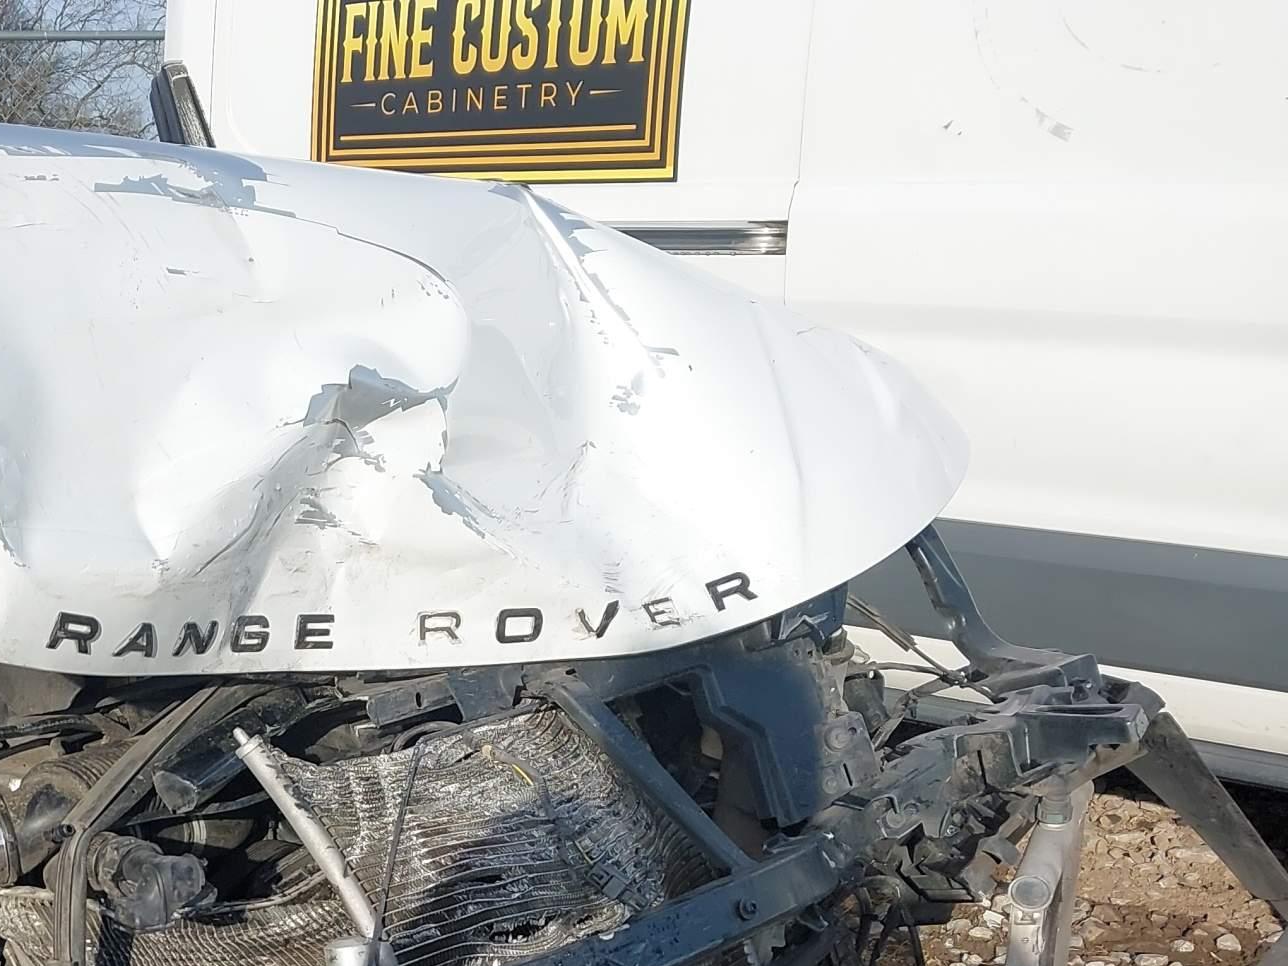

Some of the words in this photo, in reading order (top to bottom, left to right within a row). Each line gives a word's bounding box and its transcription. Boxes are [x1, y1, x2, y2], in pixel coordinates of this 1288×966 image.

[341, 2, 437, 83] FINE
[452, 0, 649, 75] CUSTOM
[380, 80, 585, 116] CABINETRY
[45, 611, 336, 658] RANGE
[416, 571, 758, 646] ROVER
